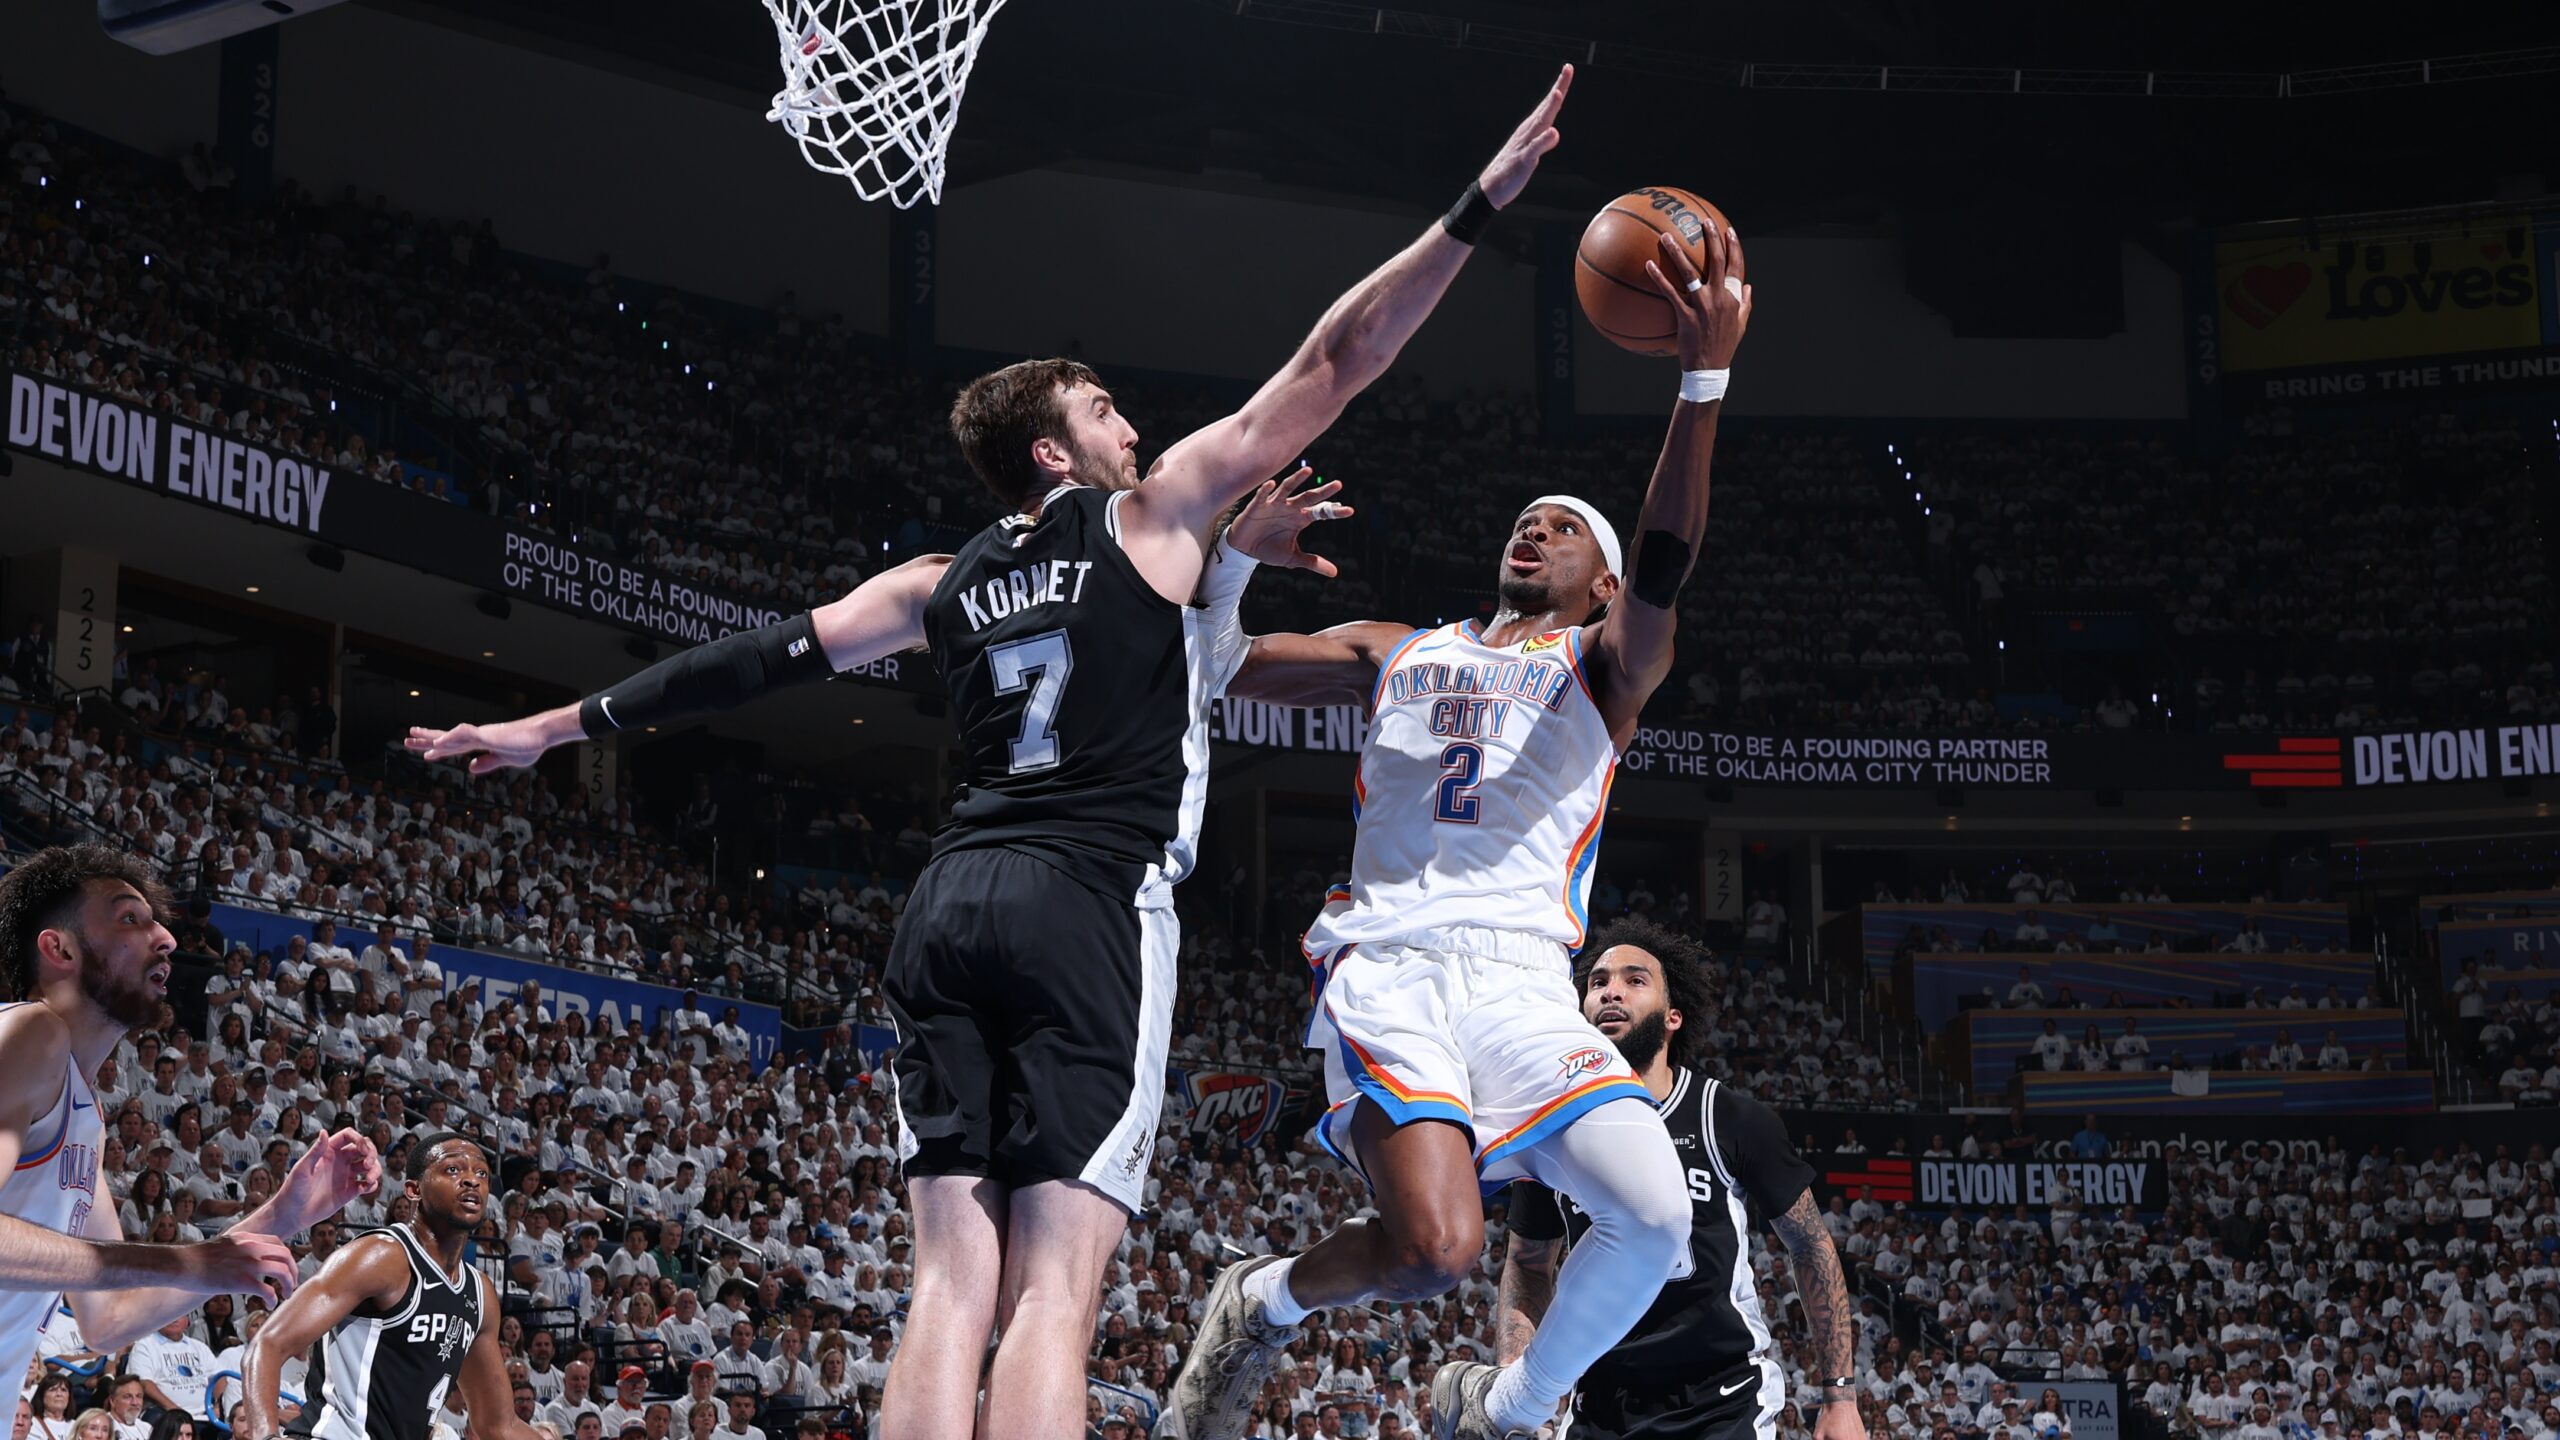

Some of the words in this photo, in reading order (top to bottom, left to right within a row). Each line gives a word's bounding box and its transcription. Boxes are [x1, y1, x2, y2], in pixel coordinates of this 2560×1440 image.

[251, 64, 272, 148] 326
[915, 229, 932, 305] 327
[1551, 307, 1569, 379] 328
[2197, 315, 2217, 385] 329
[2265, 375, 2367, 400] BRING
[2376, 366, 2441, 391] THE
[8, 373, 157, 485] DEVON
[168, 422, 331, 533] ENERGY
[505, 532, 580, 576] PROUD
[585, 556, 614, 587] TO
[619, 568, 645, 598] BE
[649, 579, 665, 604] A
[959, 559, 1092, 632] KORNET
[77, 588, 94, 671] 225
[503, 561, 534, 591] OF
[541, 572, 583, 608] THE
[590, 588, 712, 643] OKLAHOMA
[985, 627, 1074, 775] 7
[1388, 659, 1573, 712] OKLAHOMA
[1429, 699, 1512, 739] CITY
[1709, 733, 1740, 754] TO
[1746, 736, 1775, 757] BE
[1780, 739, 1798, 758] A
[1804, 738, 1932, 759] FOUNDING
[1938, 739, 2049, 759] PARTNER
[591, 739, 604, 794] 25
[1434, 741, 1485, 825] 2
[1625, 751, 1656, 772] OF
[1664, 753, 1709, 776] THE
[1716, 757, 1858, 782] OKLAHOMA
[1865, 762, 1923, 782] CITY
[1932, 763, 2050, 783] THUNDER
[2353, 728, 2488, 786] DEVON
[1717, 848, 1729, 911] 227
[1192, 1085, 1266, 1133] OKC
[1920, 1161, 2017, 1205] DEVON
[427, 1373, 452, 1426] 4
